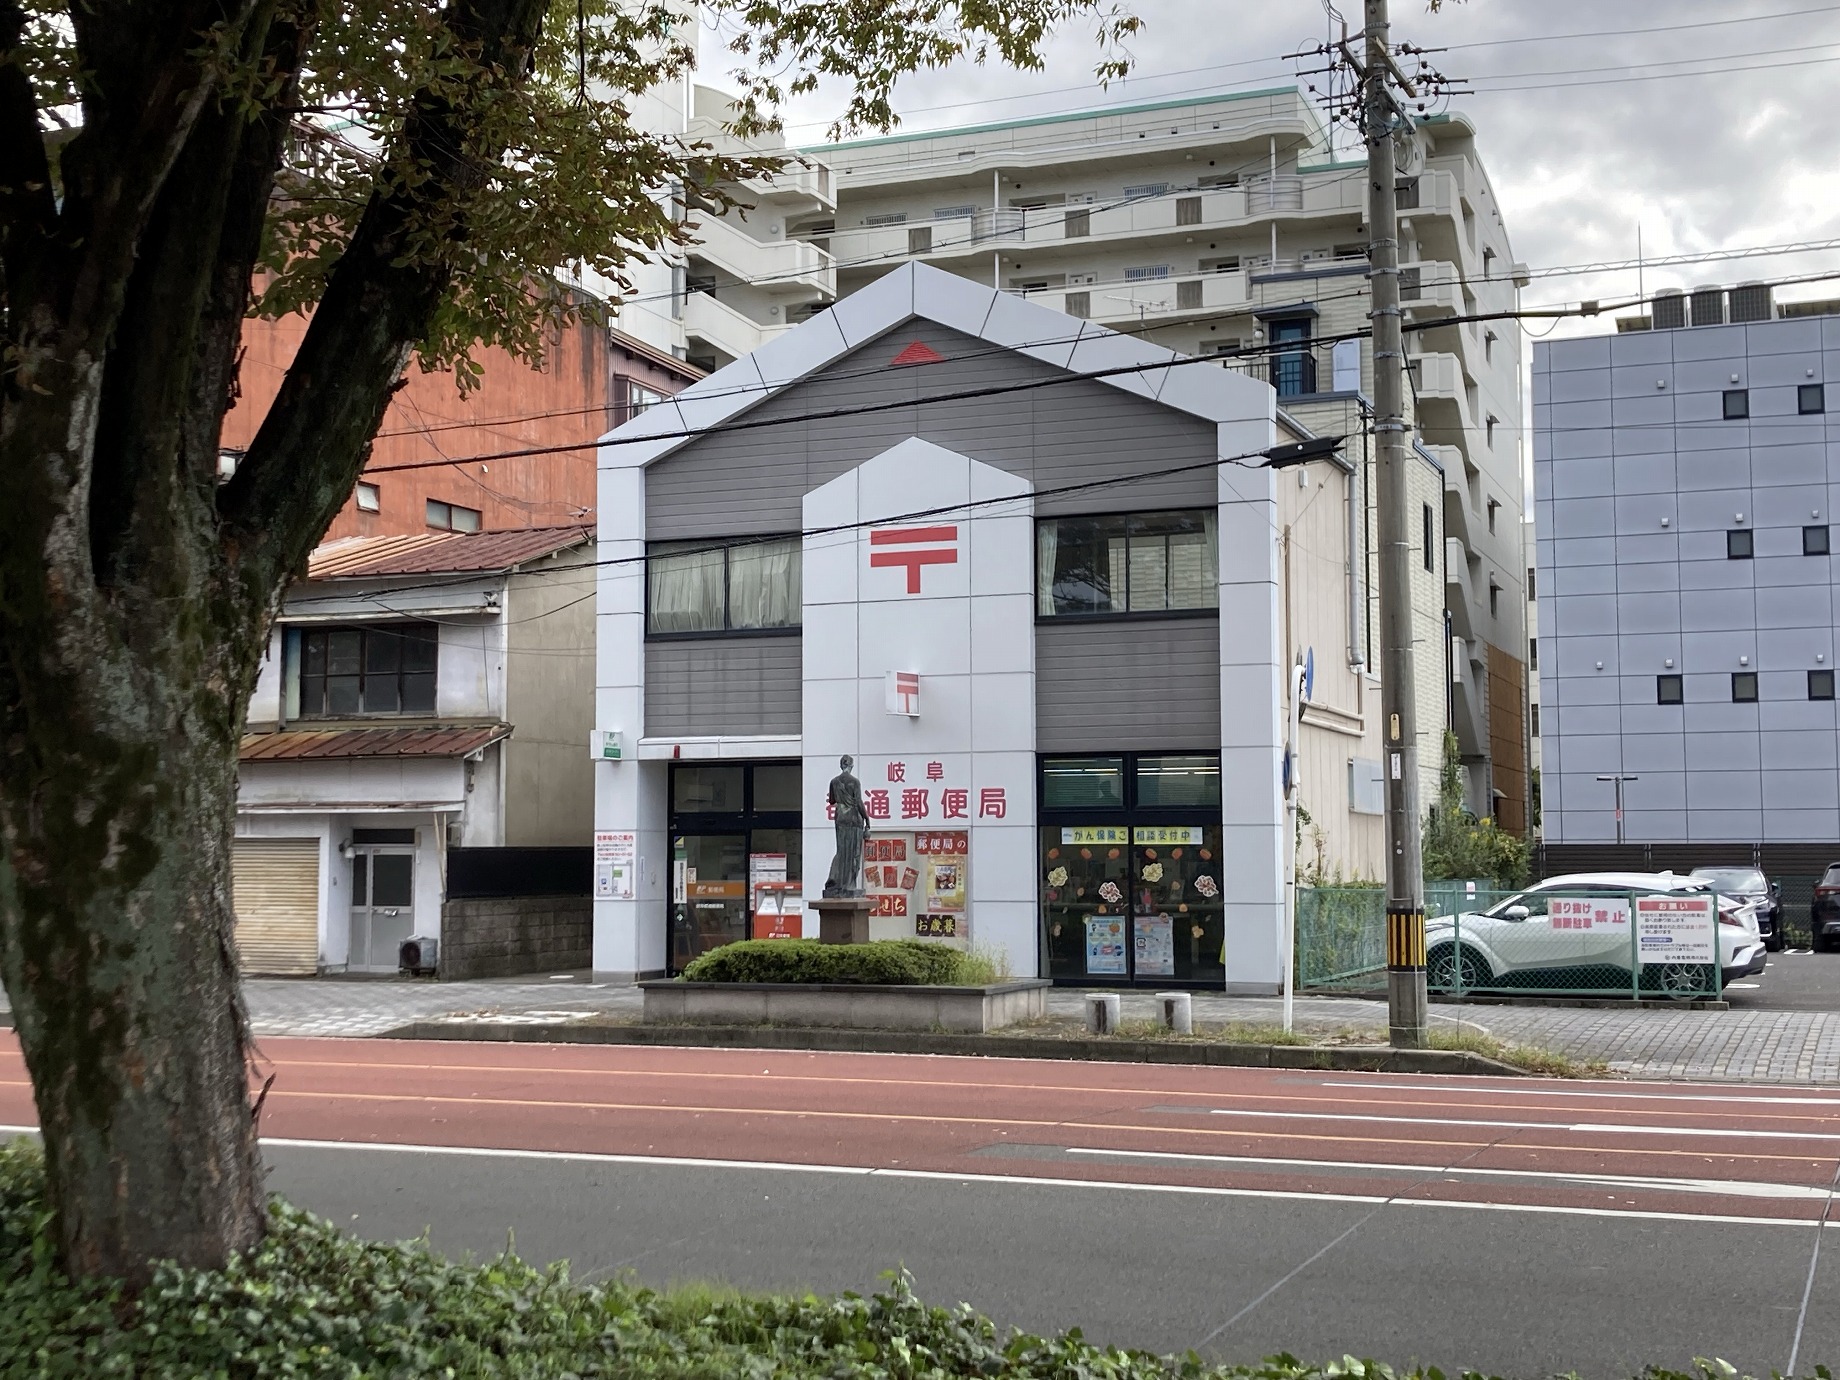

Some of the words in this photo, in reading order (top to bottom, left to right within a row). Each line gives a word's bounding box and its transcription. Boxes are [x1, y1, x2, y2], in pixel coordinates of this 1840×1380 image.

[887, 761, 944, 783] 岐阜
[826, 788, 1007, 820] 通郵便局
[1074, 829, 1127, 841] がん保険ご
[1136, 830, 1190, 842] 相談受付中
[917, 838, 966, 850] 郵便局の
[870, 897, 905, 913] せち
[1552, 902, 1592, 914] 通り抜け
[1594, 910, 1626, 923] 禁止
[917, 918, 955, 933] お歳暮
